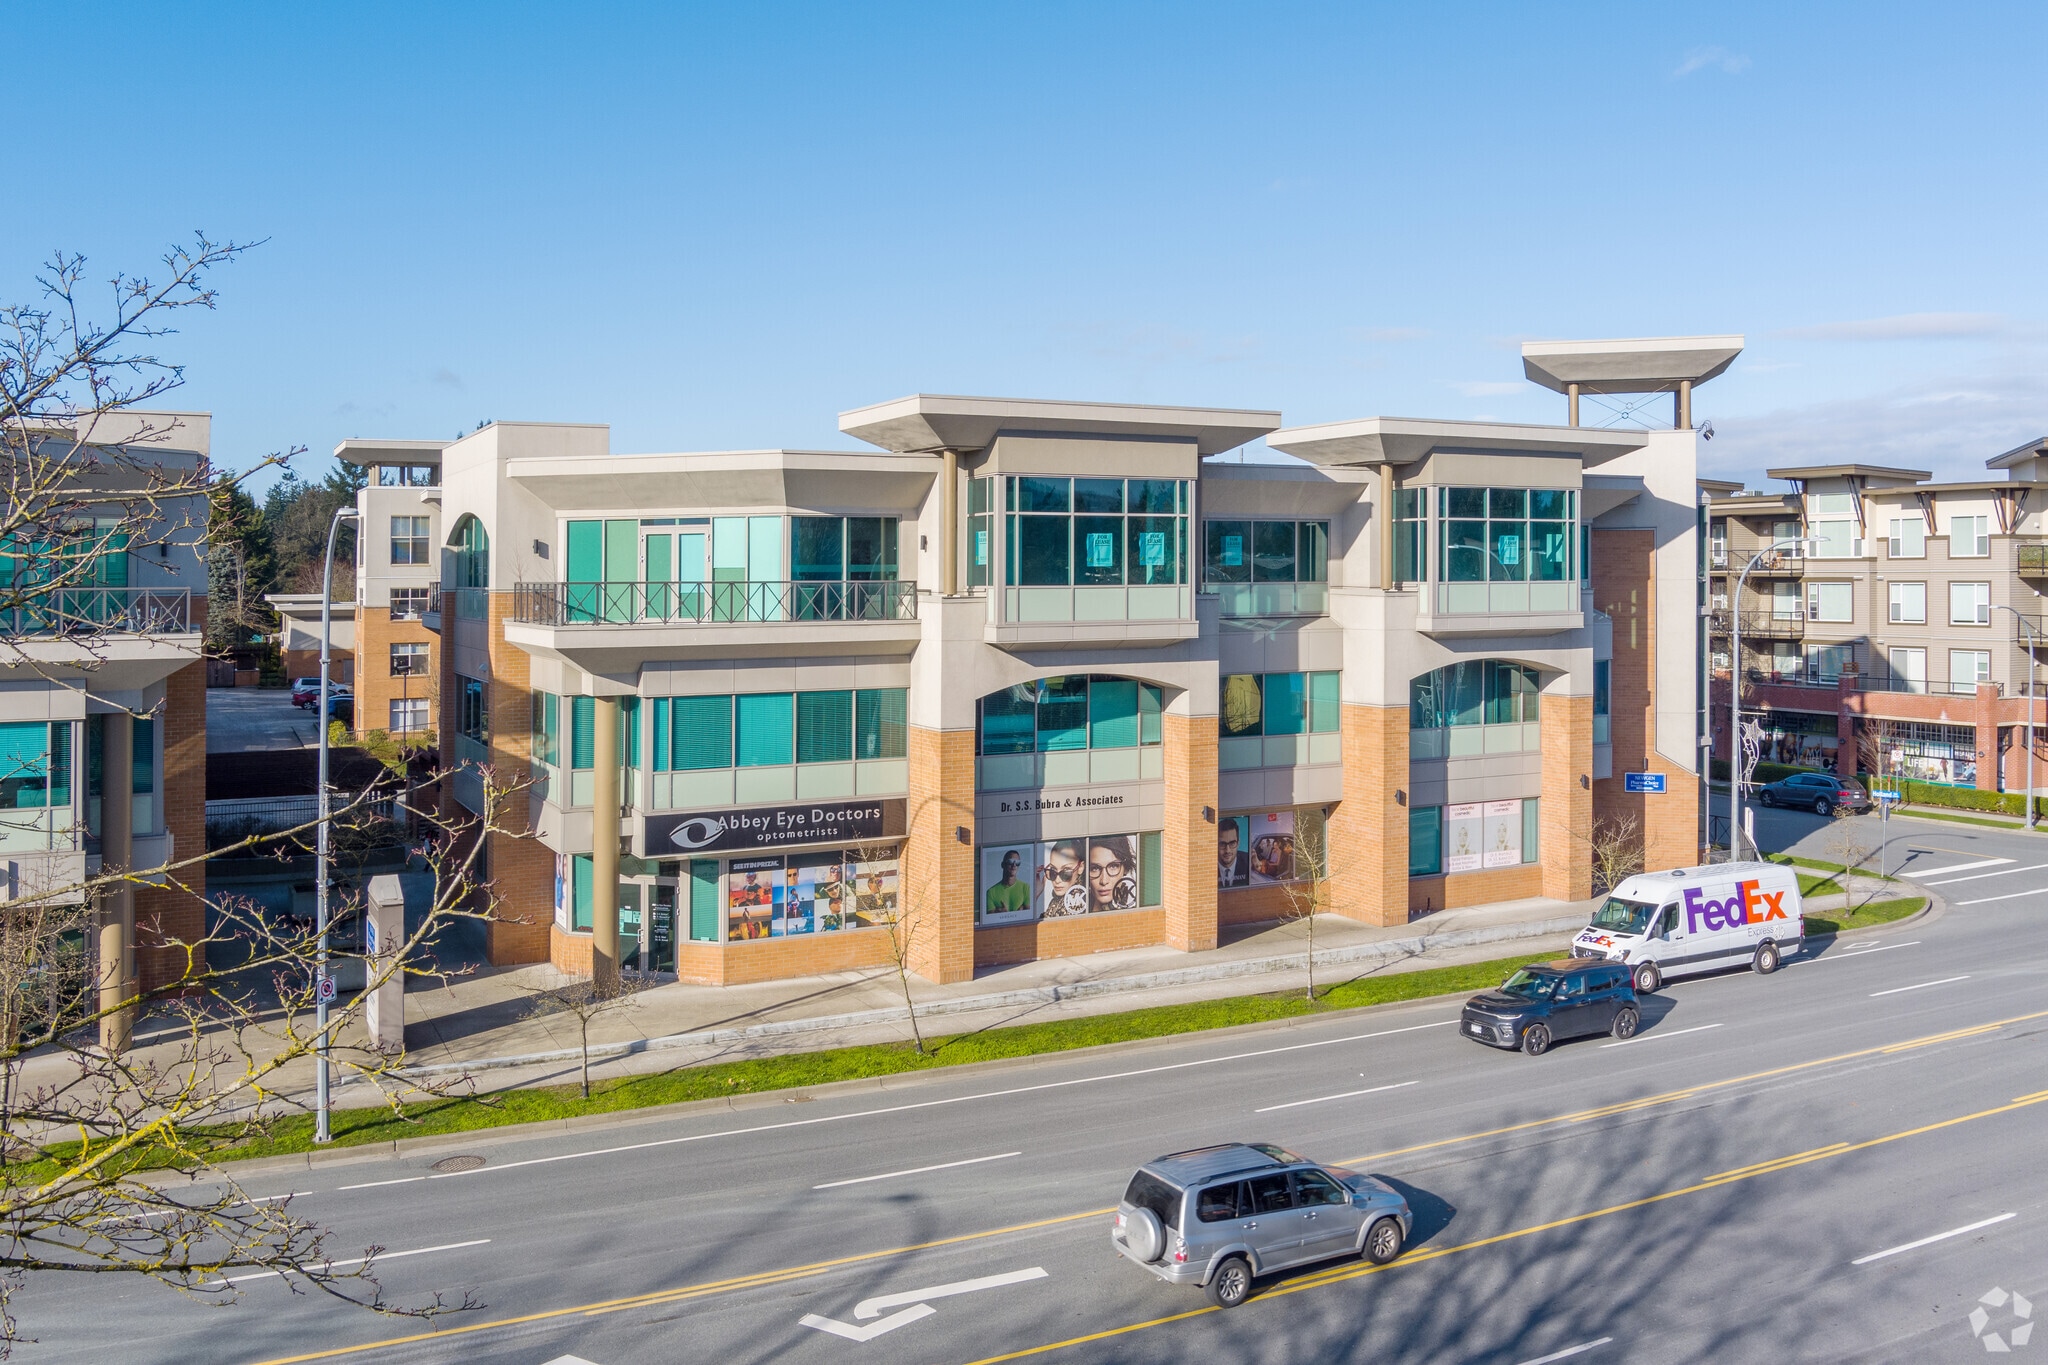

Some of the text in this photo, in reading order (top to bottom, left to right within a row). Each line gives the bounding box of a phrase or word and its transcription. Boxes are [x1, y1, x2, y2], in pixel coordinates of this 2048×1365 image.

[1807, 748, 1820, 758] MY
[1806, 756, 1820, 766] LIFE
[1907, 758, 1924, 768] LIFE
[1001, 796, 1124, 812] Dr. S.S. Bubra & Associates
[716, 808, 880, 830] Abbey Eye Doctors
[757, 828, 838, 842] optometrists
[1683, 879, 1788, 934] FedEx
[1748, 926, 1774, 937] Express
[1576, 933, 1615, 948] FedEx
